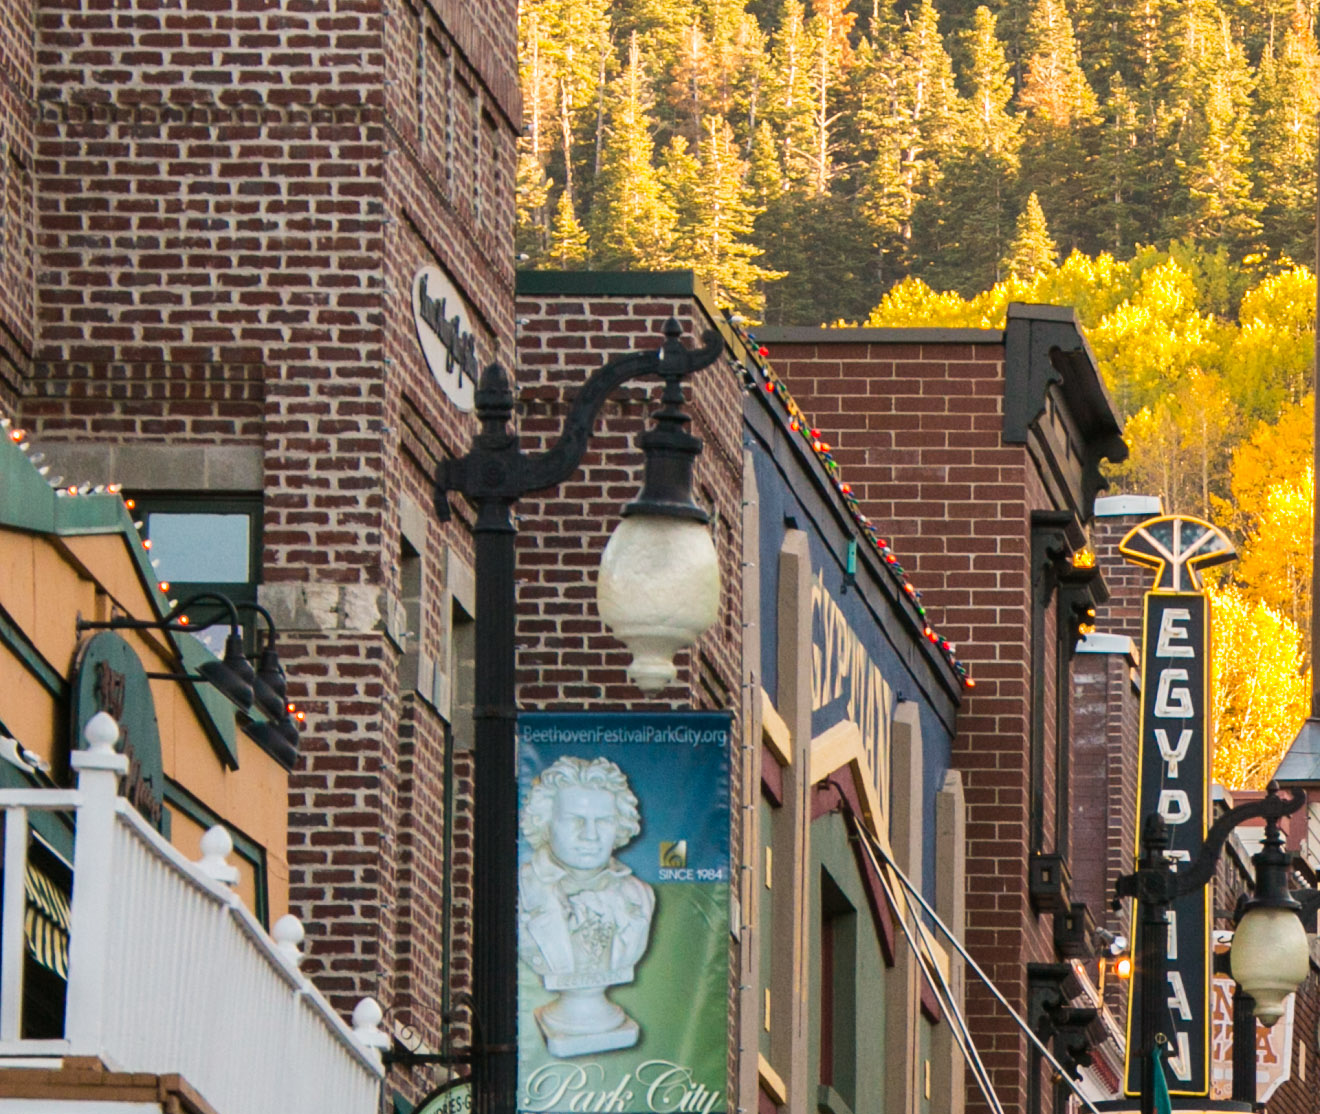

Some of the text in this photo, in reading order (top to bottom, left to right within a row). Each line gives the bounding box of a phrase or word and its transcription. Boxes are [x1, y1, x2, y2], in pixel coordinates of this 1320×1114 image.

[523, 725, 727, 746] BeethovenFestivalParkCity.org
[659, 869, 723, 881] SINCE 1984
[524, 1063, 633, 1112] Park
